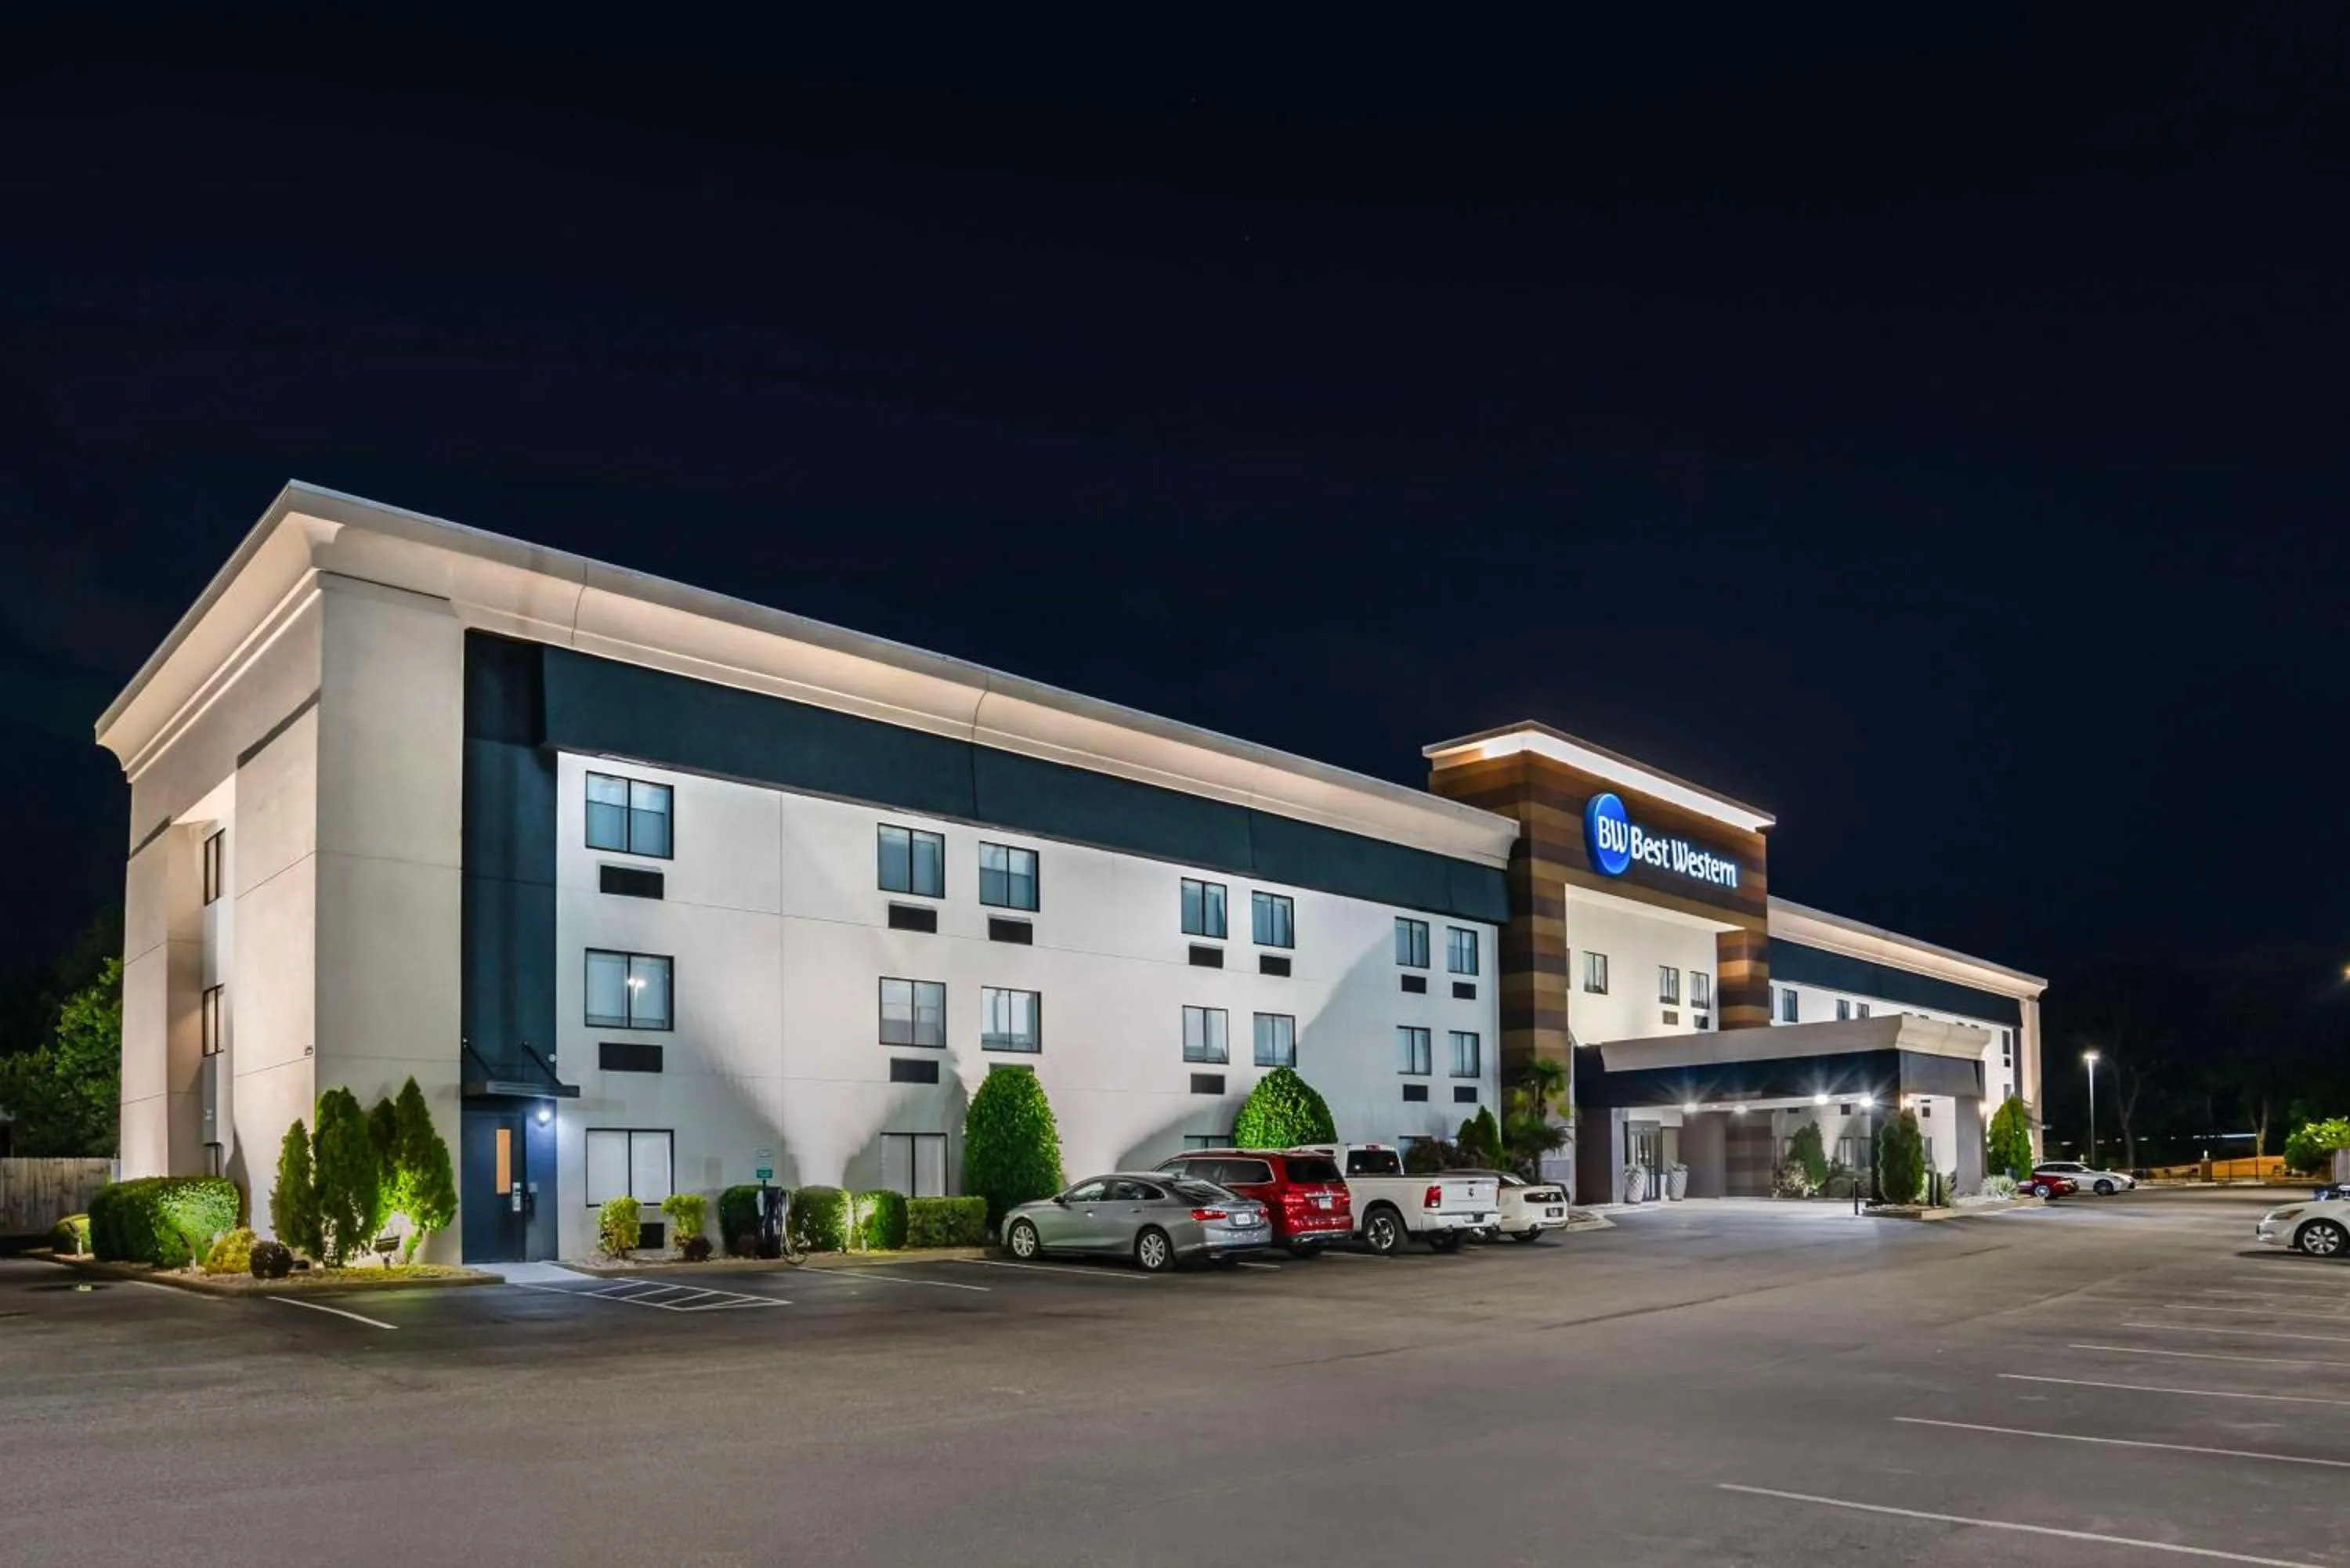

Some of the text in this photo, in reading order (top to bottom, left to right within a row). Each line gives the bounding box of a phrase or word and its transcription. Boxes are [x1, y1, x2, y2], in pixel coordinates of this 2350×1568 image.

[1597, 815, 1737, 887] BW Best Western
